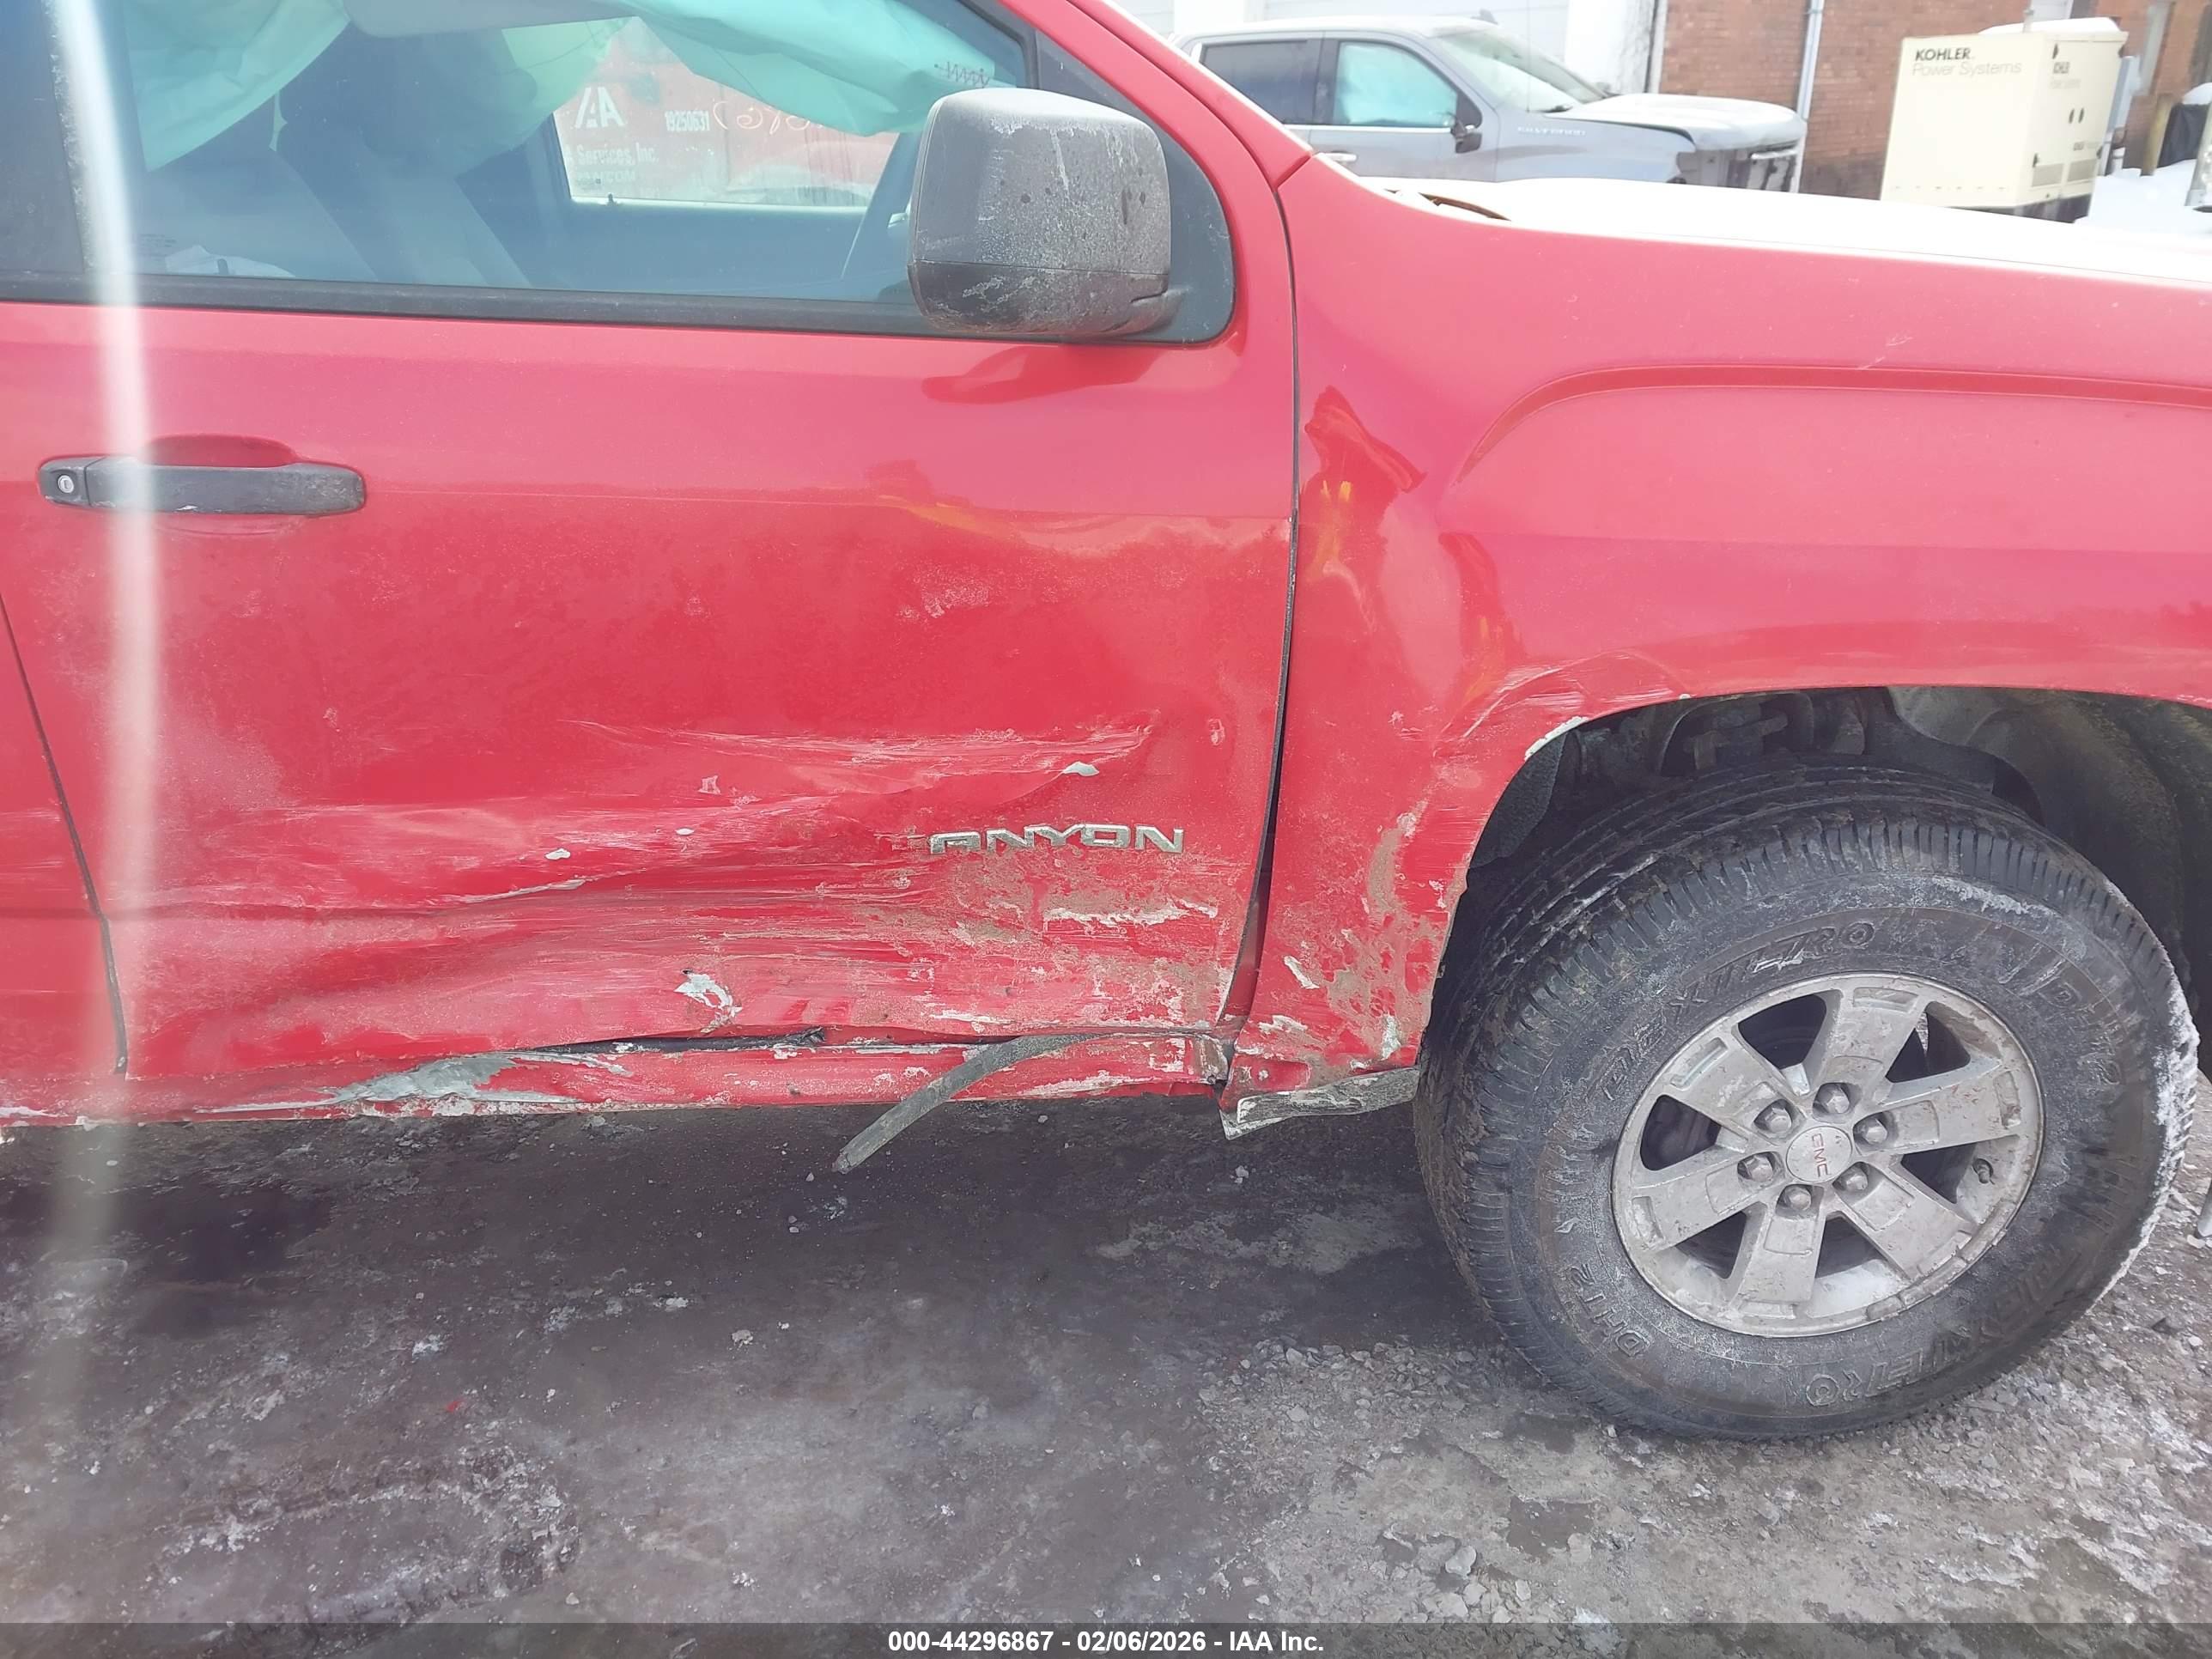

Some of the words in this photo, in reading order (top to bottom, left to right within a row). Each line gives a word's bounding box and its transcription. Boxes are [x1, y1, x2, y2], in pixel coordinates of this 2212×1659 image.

[1915, 47, 1972, 61] KOHLER
[1911, 62, 1955, 76] Power
[1959, 61, 2022, 78] Systems
[1812, 1133, 1829, 1178] GMC
